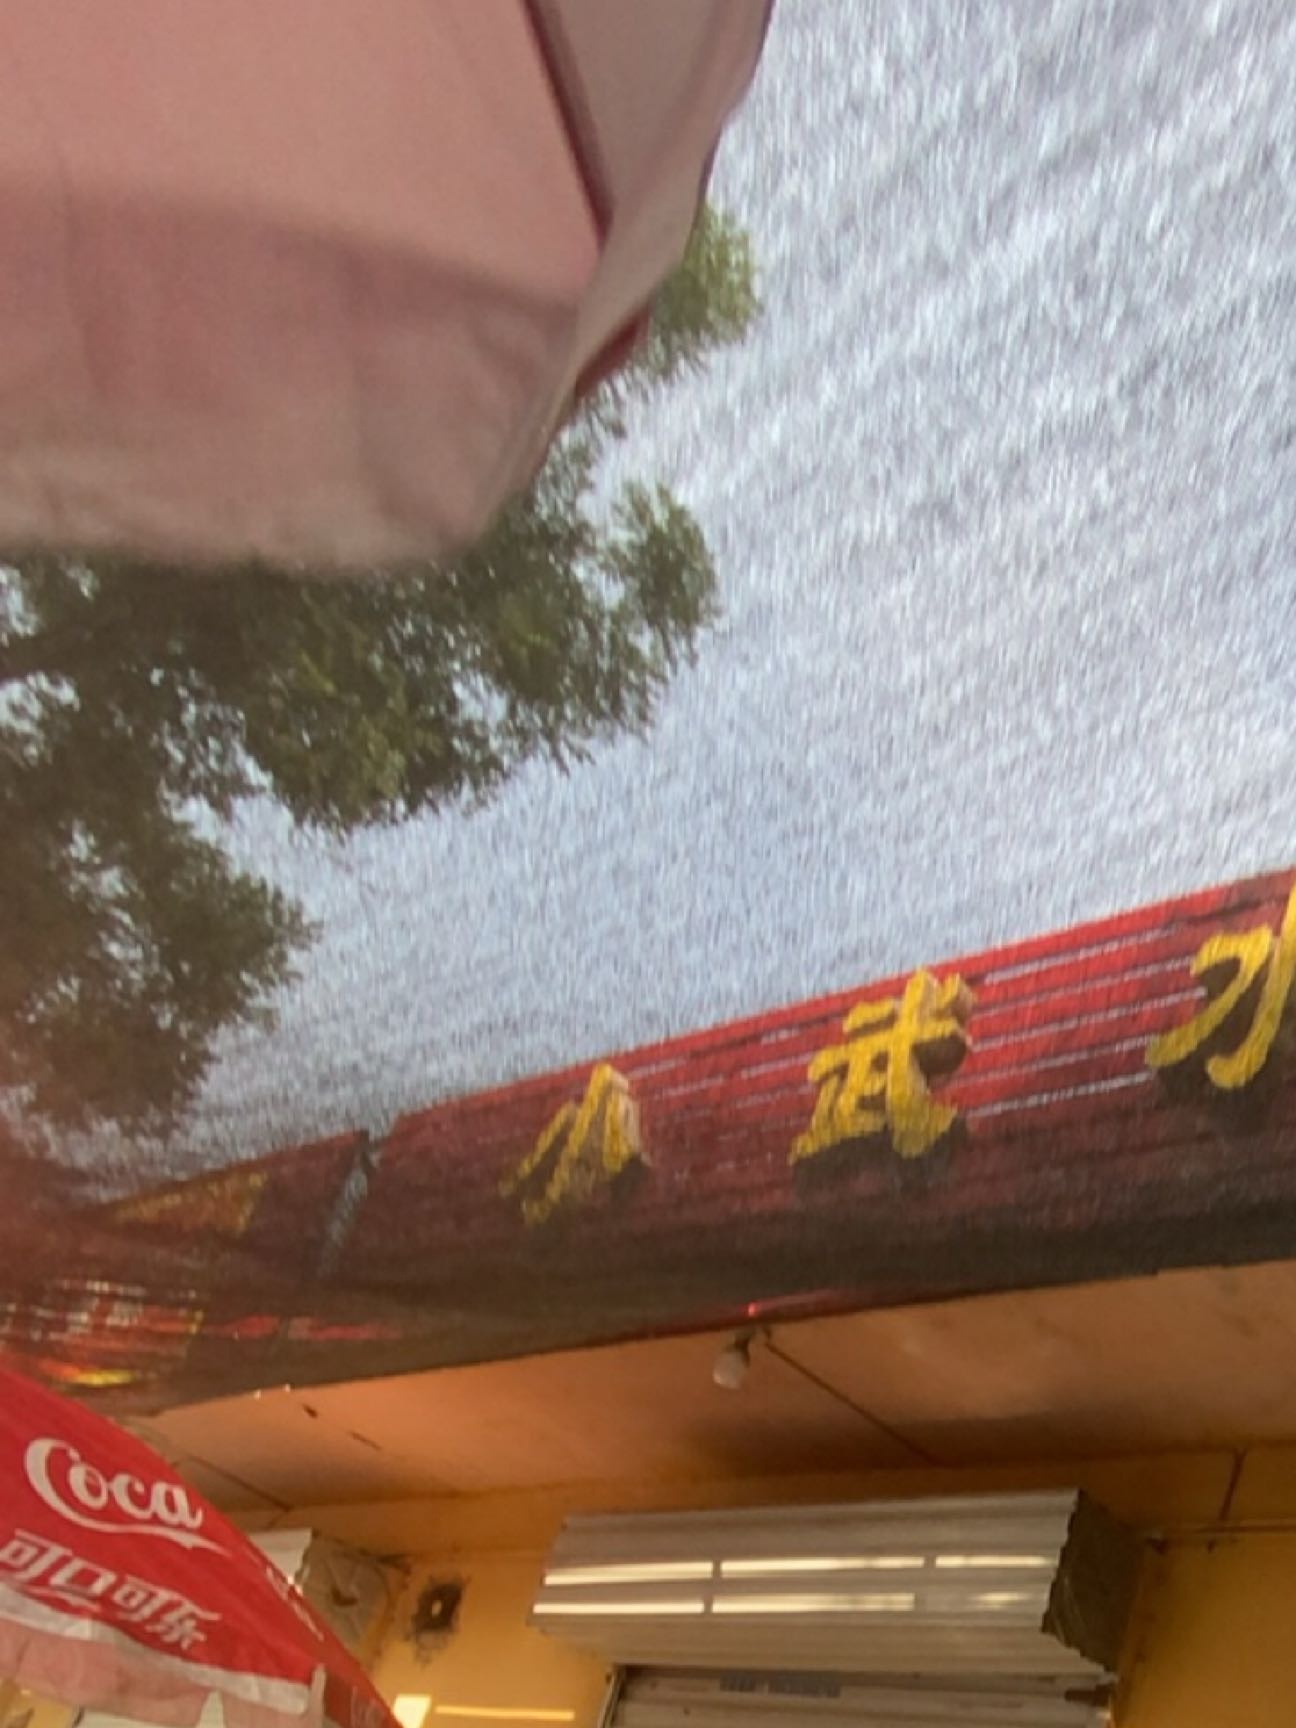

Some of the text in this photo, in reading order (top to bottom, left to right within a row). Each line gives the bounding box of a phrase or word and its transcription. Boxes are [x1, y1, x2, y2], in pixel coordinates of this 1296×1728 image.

[24, 1438, 212, 1548] Coca
[0, 1531, 222, 1651] 可口可乐
